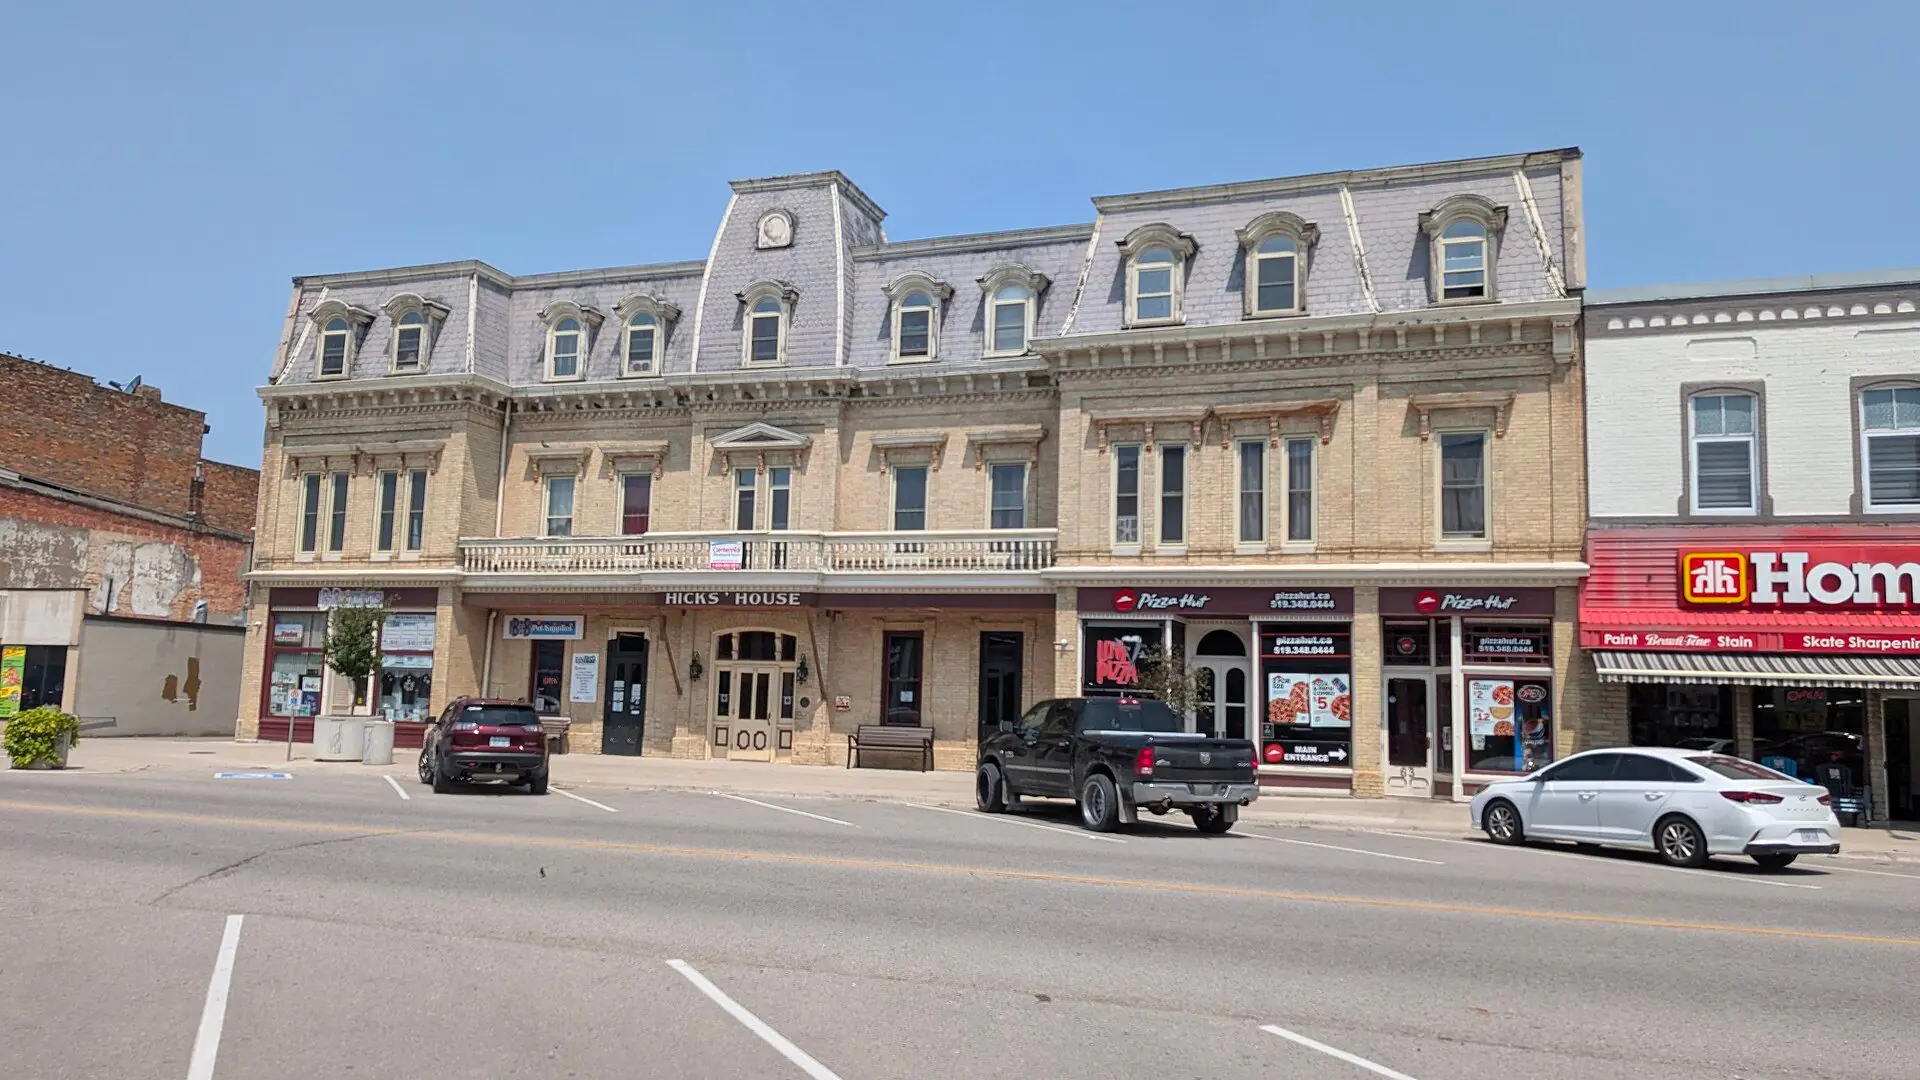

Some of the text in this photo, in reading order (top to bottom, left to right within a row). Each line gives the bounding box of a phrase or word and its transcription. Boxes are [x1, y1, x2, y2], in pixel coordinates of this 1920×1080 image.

[735, 593, 800, 605] HOUSE
[1137, 593, 1211, 609] Pizza Hut
[1440, 594, 1518, 610] Pizza Hut
[1604, 633, 1638, 645] Paint
[1717, 635, 1753, 647] Stain
[1803, 635, 1845, 648] Skate
[1284, 753, 1329, 762] ENTRANCE
